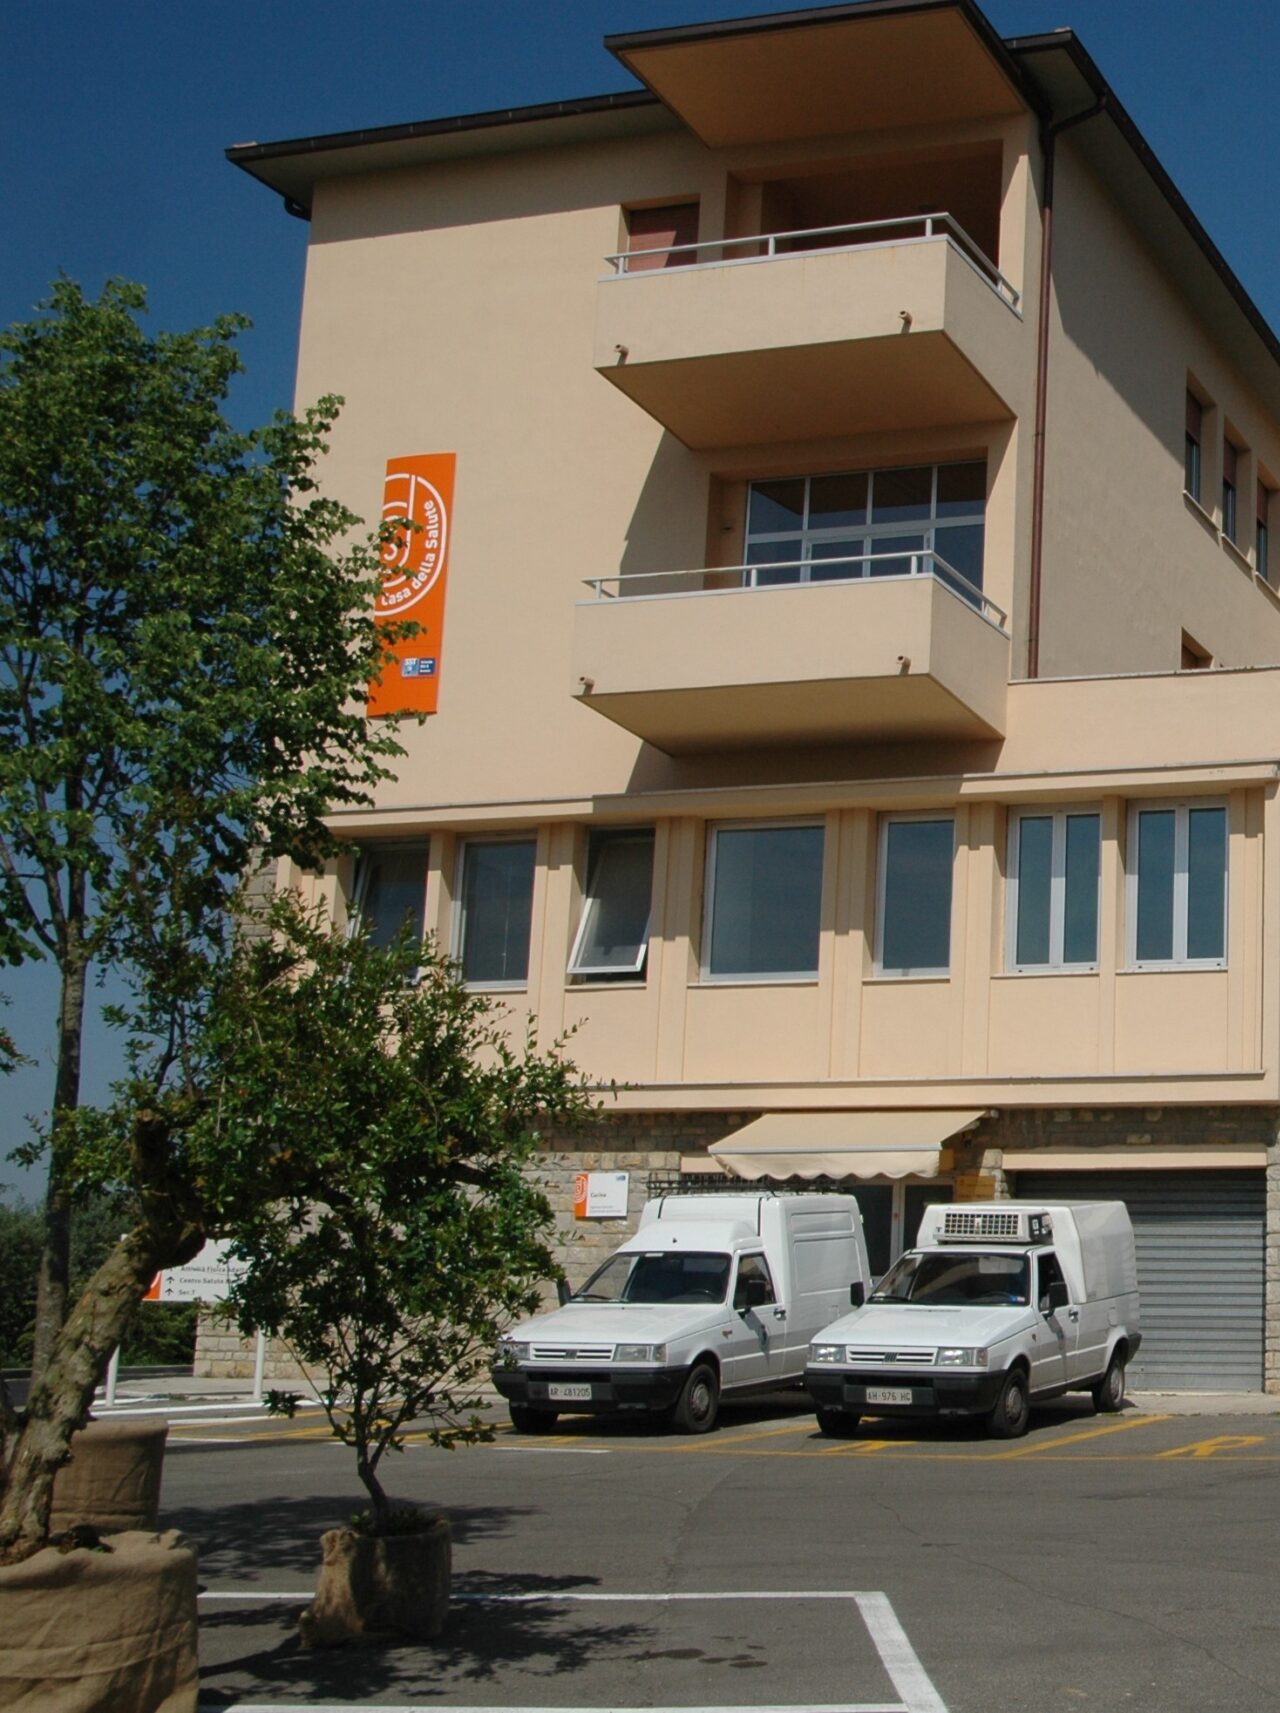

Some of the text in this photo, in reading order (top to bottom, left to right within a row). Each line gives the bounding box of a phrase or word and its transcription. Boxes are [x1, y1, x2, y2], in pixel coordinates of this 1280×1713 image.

[381, 500, 439, 606] Casa della Salute
